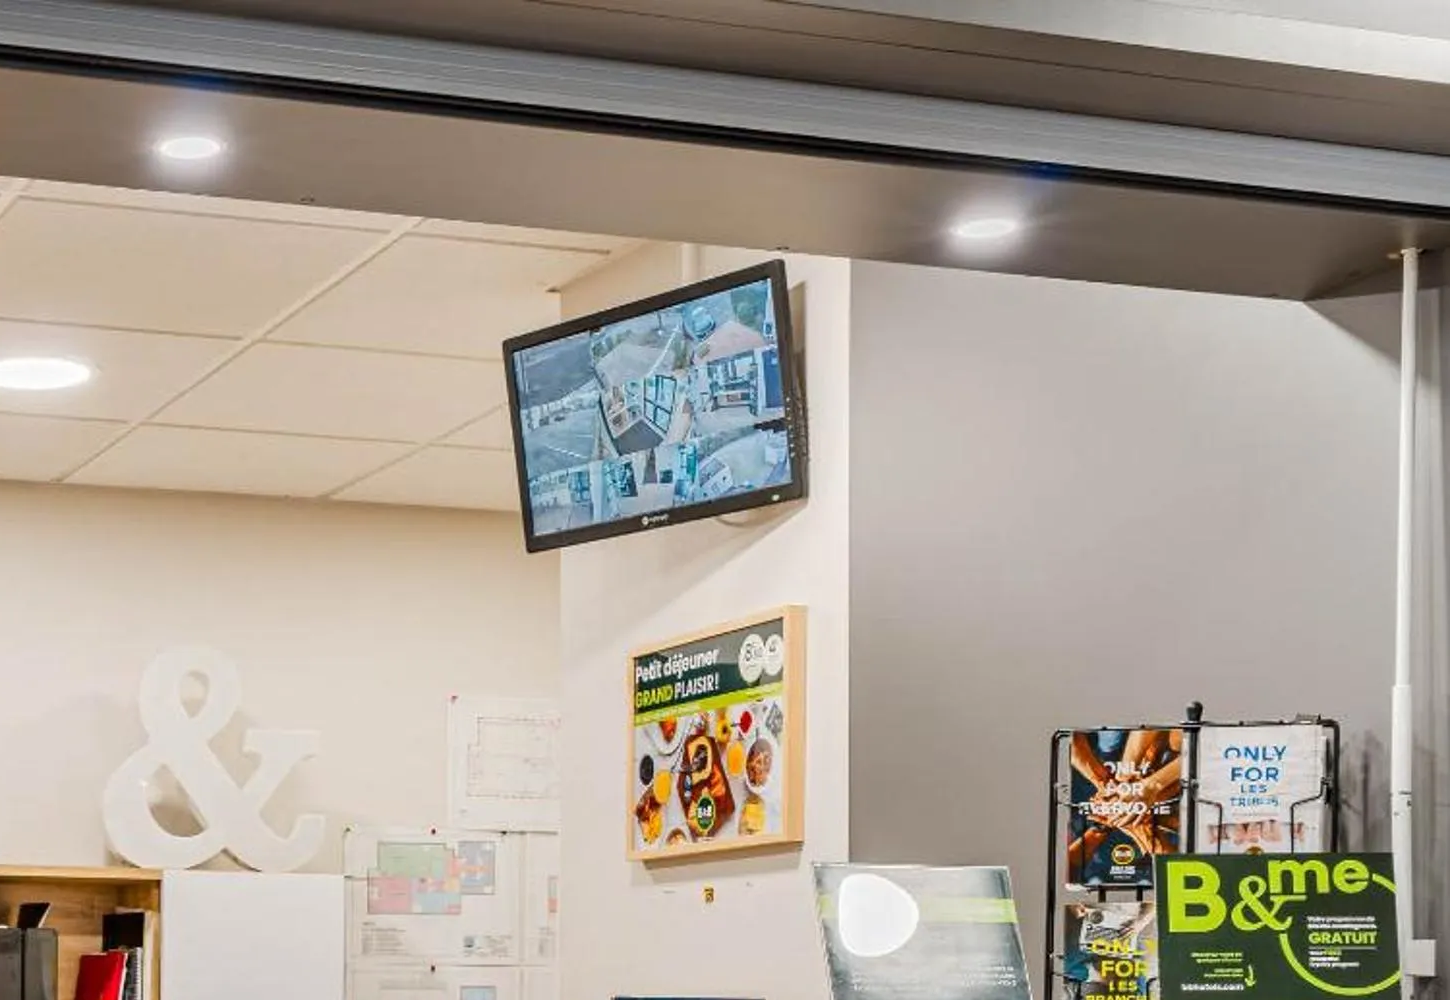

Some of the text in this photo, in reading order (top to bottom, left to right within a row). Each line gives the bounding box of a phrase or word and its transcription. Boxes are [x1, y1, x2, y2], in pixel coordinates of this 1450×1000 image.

[636, 660, 662, 684] Petit
[663, 649, 719, 679] déjeuner
[637, 685, 673, 708] GRAND
[1224, 745, 1286, 761] ONLY
[1231, 767, 1279, 781] FOR
[1240, 785, 1267, 793] LES
[1308, 931, 1378, 944] GRATUIT
